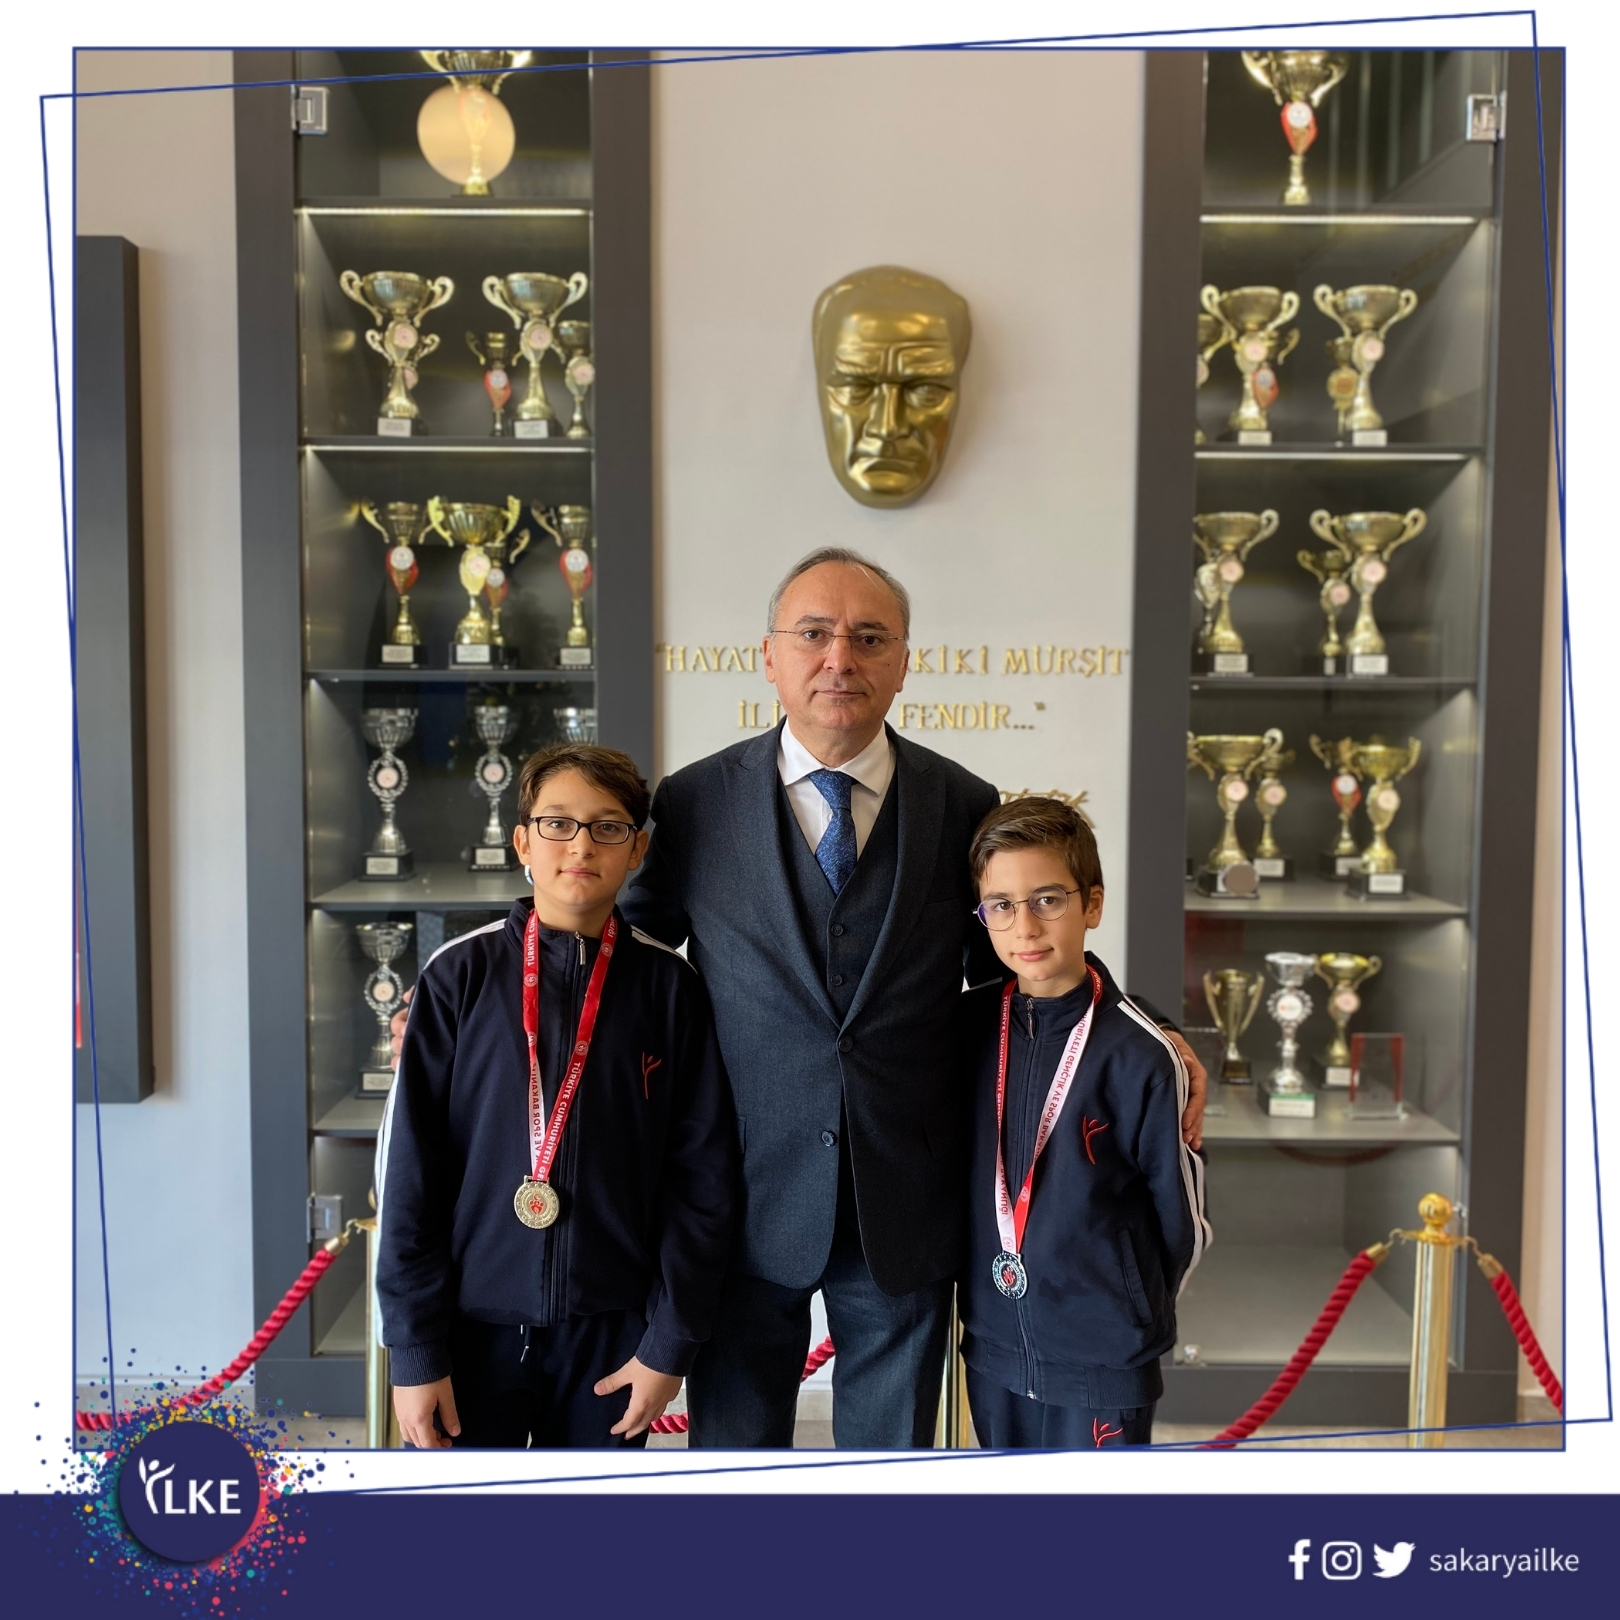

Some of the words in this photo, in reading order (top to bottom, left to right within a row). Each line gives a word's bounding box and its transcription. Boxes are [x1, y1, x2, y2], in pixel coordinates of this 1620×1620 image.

[906, 645, 988, 675] KİKİ
[1003, 645, 1130, 678] MÜRŞİT
[526, 933, 535, 967] TÜRKİYE
[562, 1062, 581, 1099] TÜRKİYE
[541, 1101, 567, 1165] CUMHURİYETİ
[536, 1166, 546, 1180] GE
